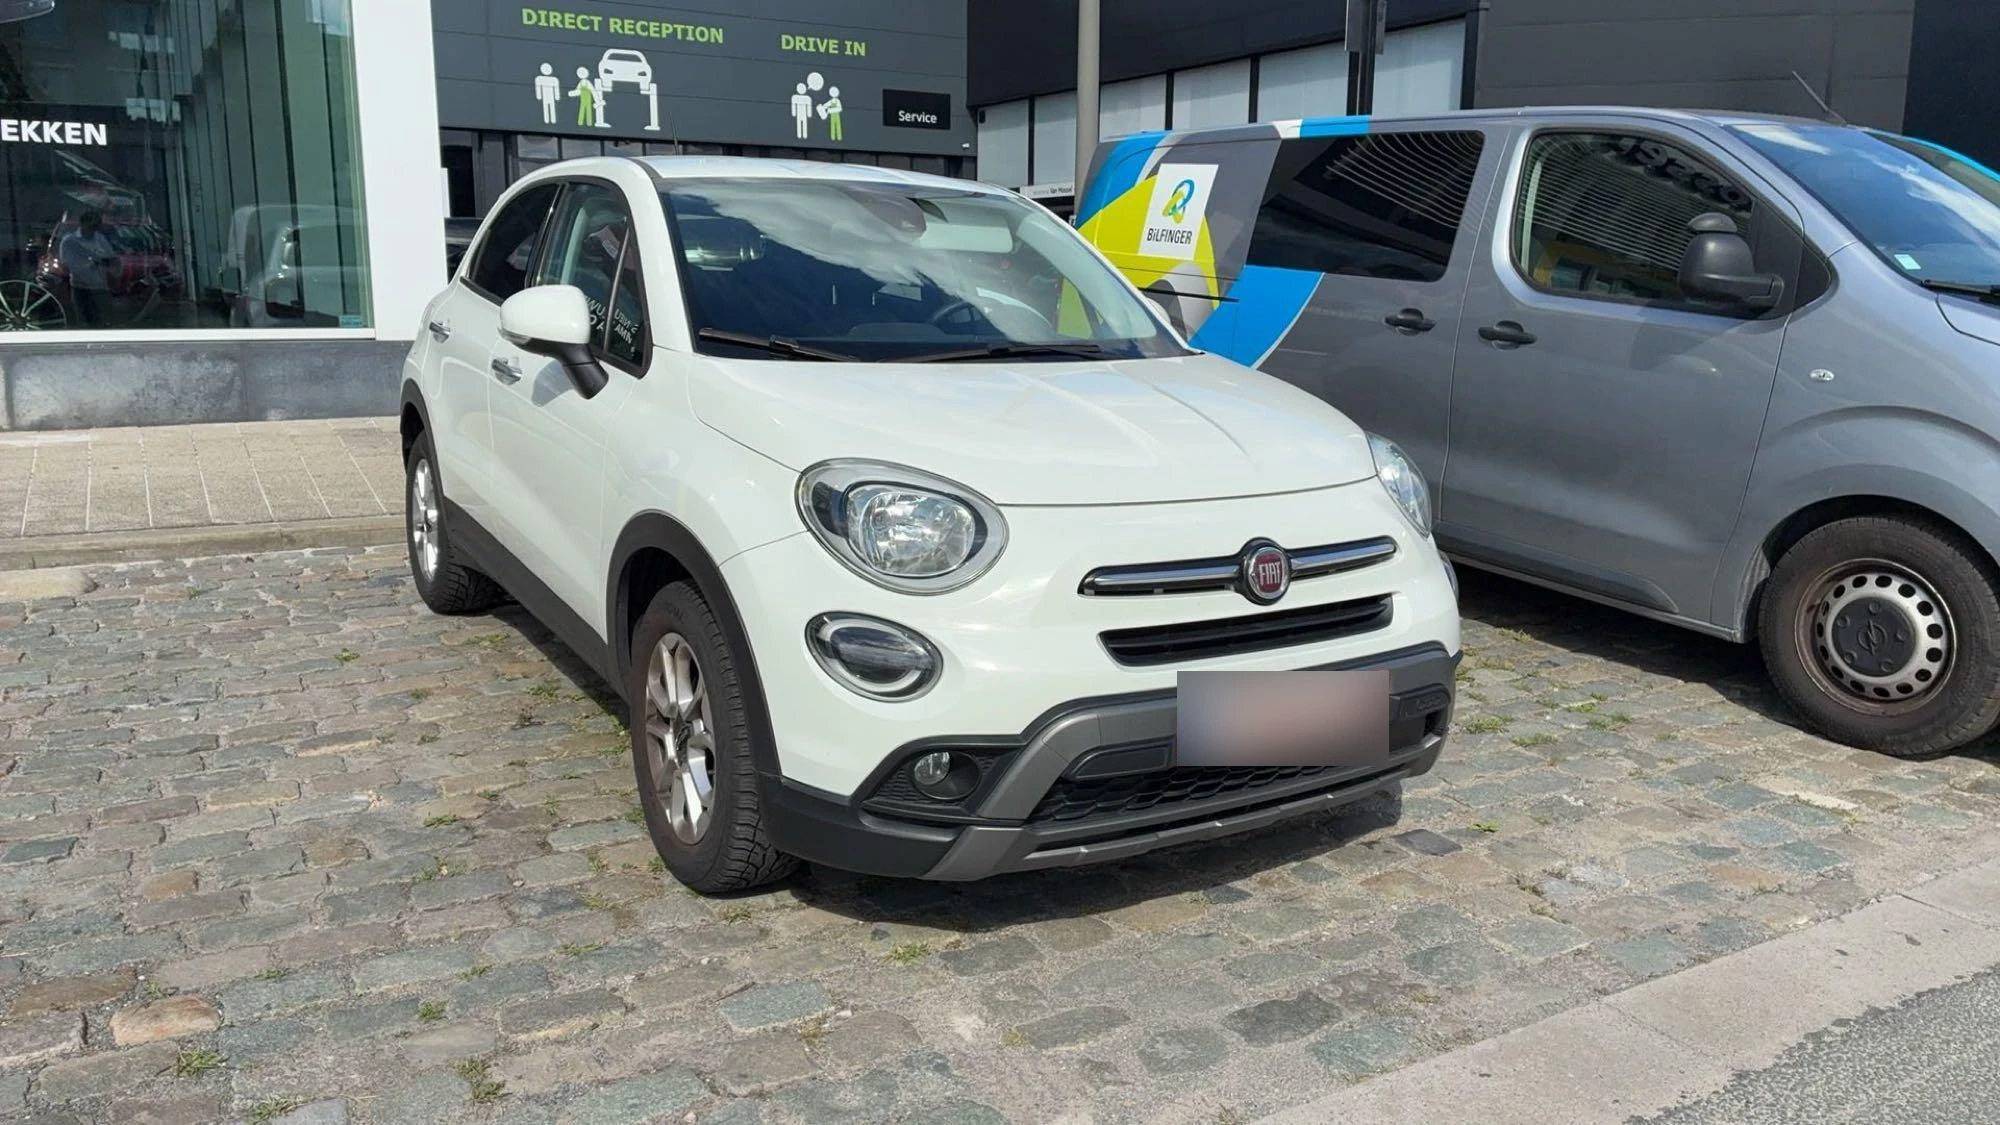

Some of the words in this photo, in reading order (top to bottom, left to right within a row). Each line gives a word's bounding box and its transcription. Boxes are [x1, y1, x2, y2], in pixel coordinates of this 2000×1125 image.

[521, 8, 603, 32] DIRECT
[609, 17, 724, 44] RECEPTION
[781, 34, 839, 54] DRIVE
[844, 40, 866, 57] IN
[898, 110, 938, 124] Service
[0, 118, 107, 146] EKKEN
[1259, 561, 1281, 586] FIAT
